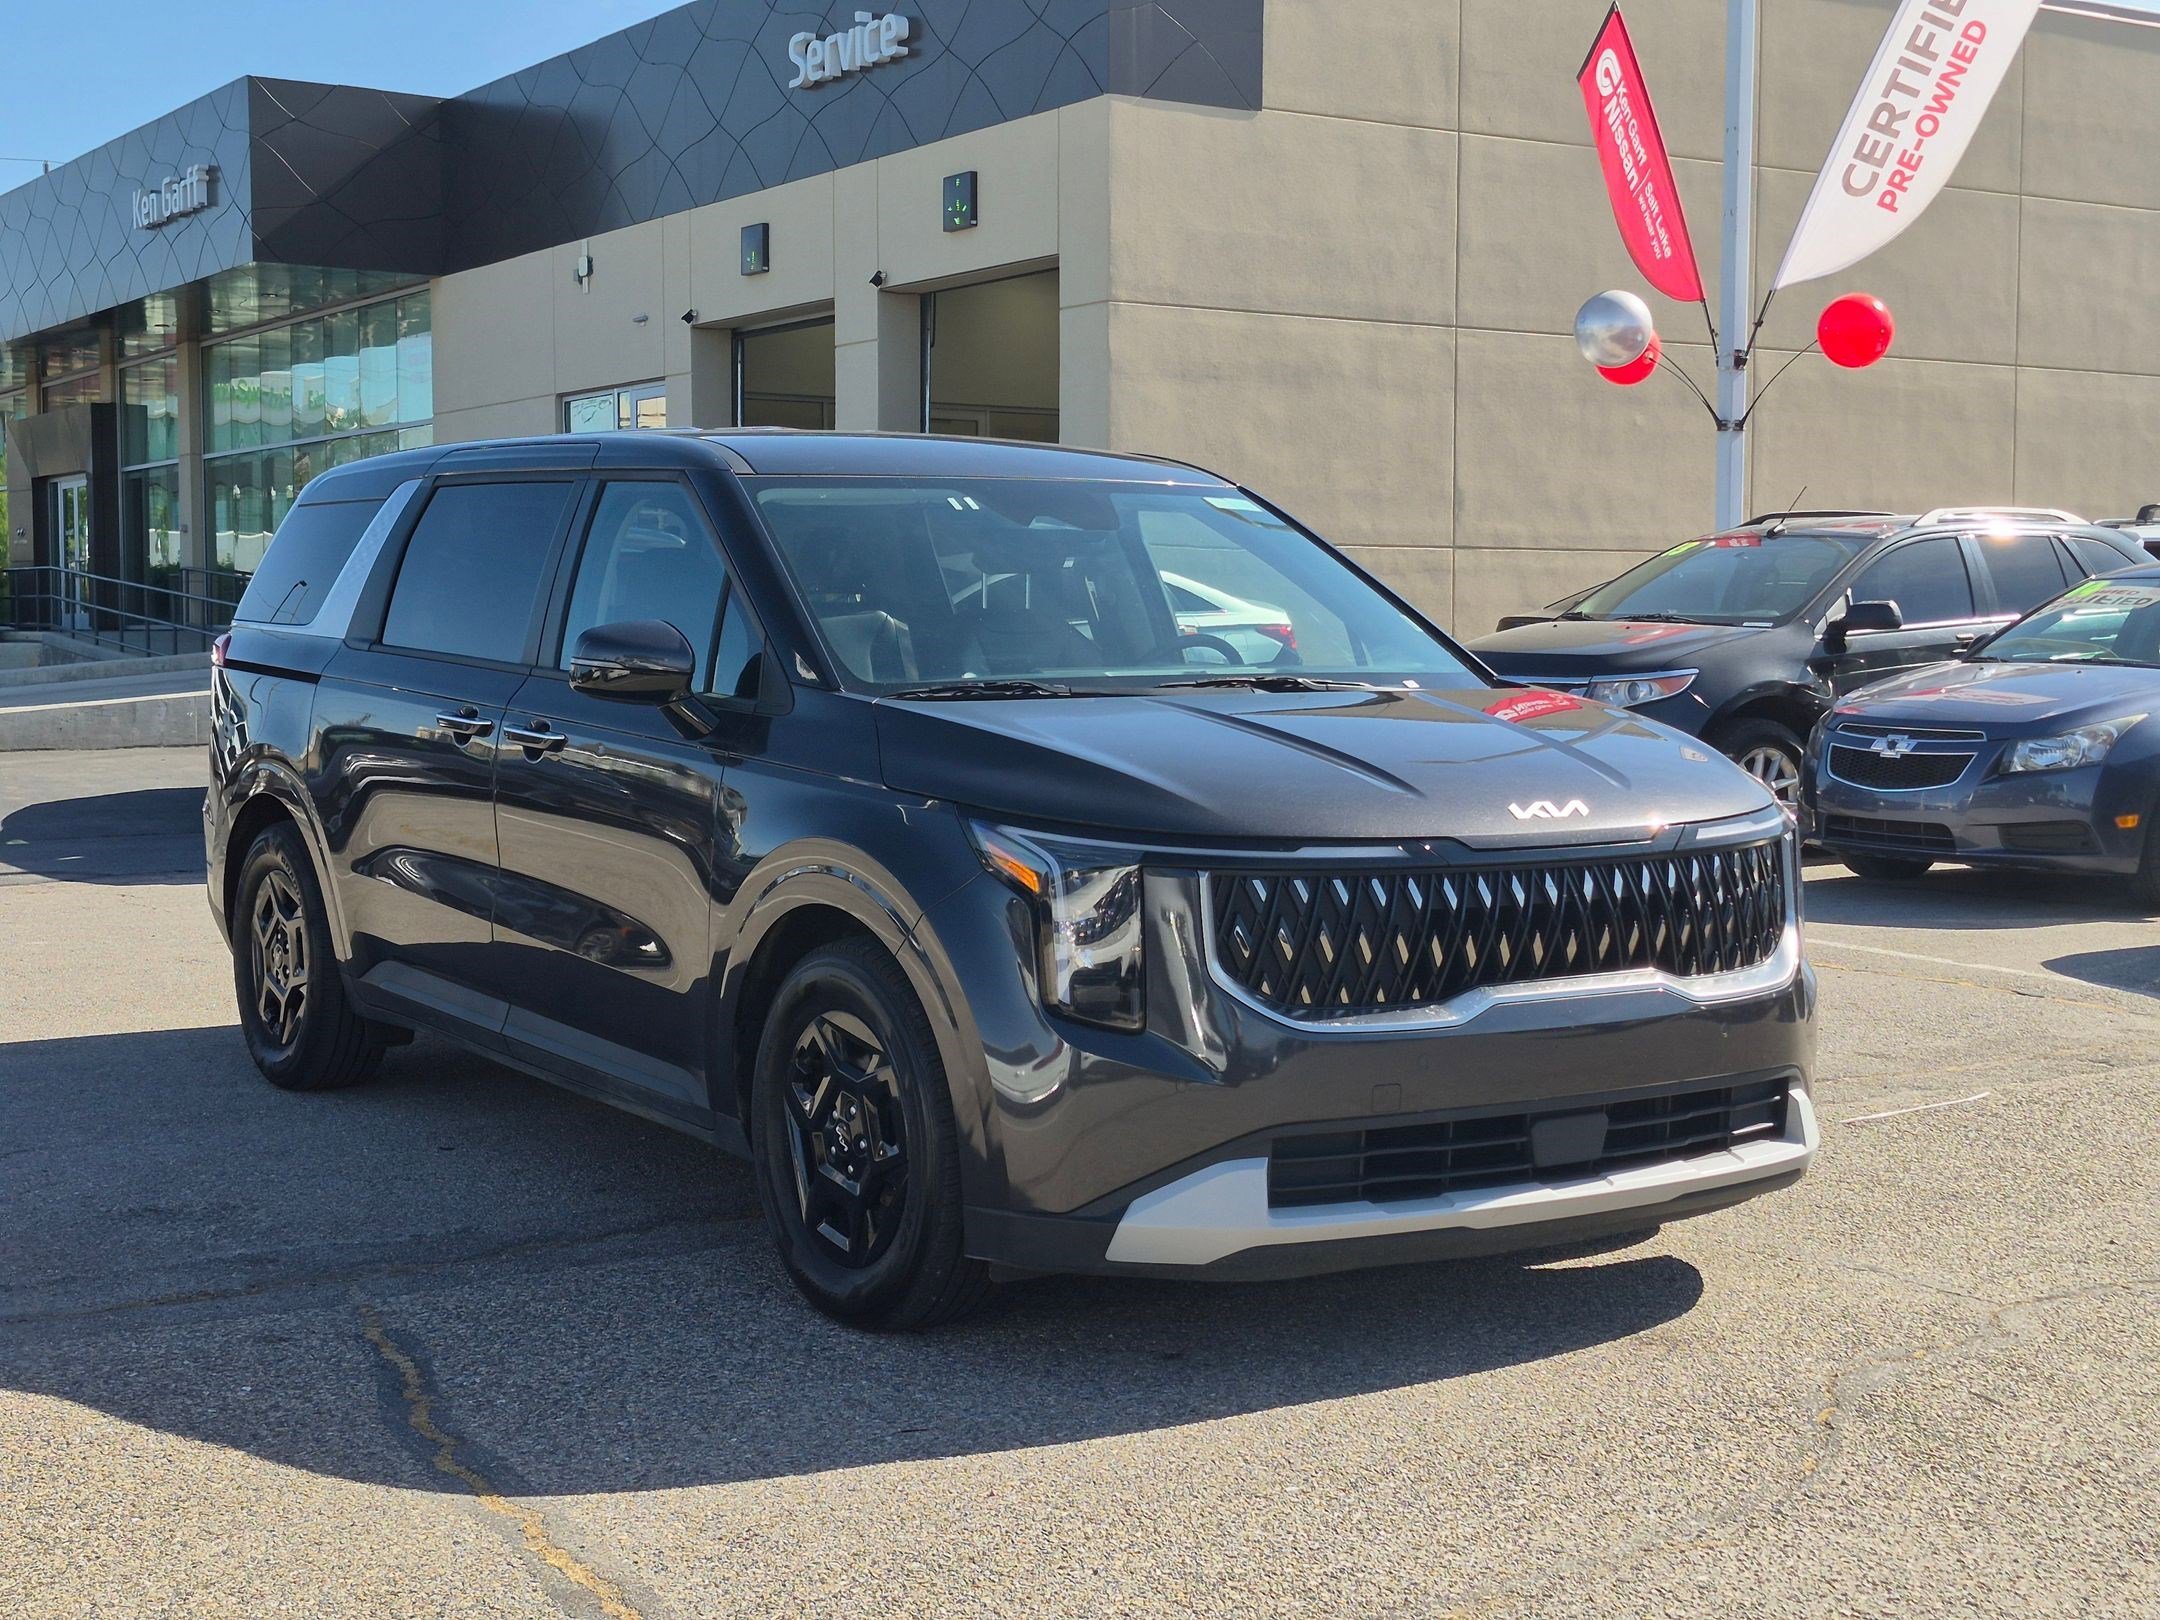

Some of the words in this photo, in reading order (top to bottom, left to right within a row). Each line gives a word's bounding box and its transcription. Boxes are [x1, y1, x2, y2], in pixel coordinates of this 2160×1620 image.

[788, 11, 909, 89] Service
[1616, 80, 1633, 122] Ken
[1876, 19, 1987, 214] PRE-OWNED
[1603, 95, 1639, 191] Nissan
[132, 188, 162, 230] Ken
[161, 164, 209, 217] Garff
[1645, 181, 1660, 218] Salt
[1655, 214, 1672, 258] Lake
[1650, 236, 1662, 260] you
